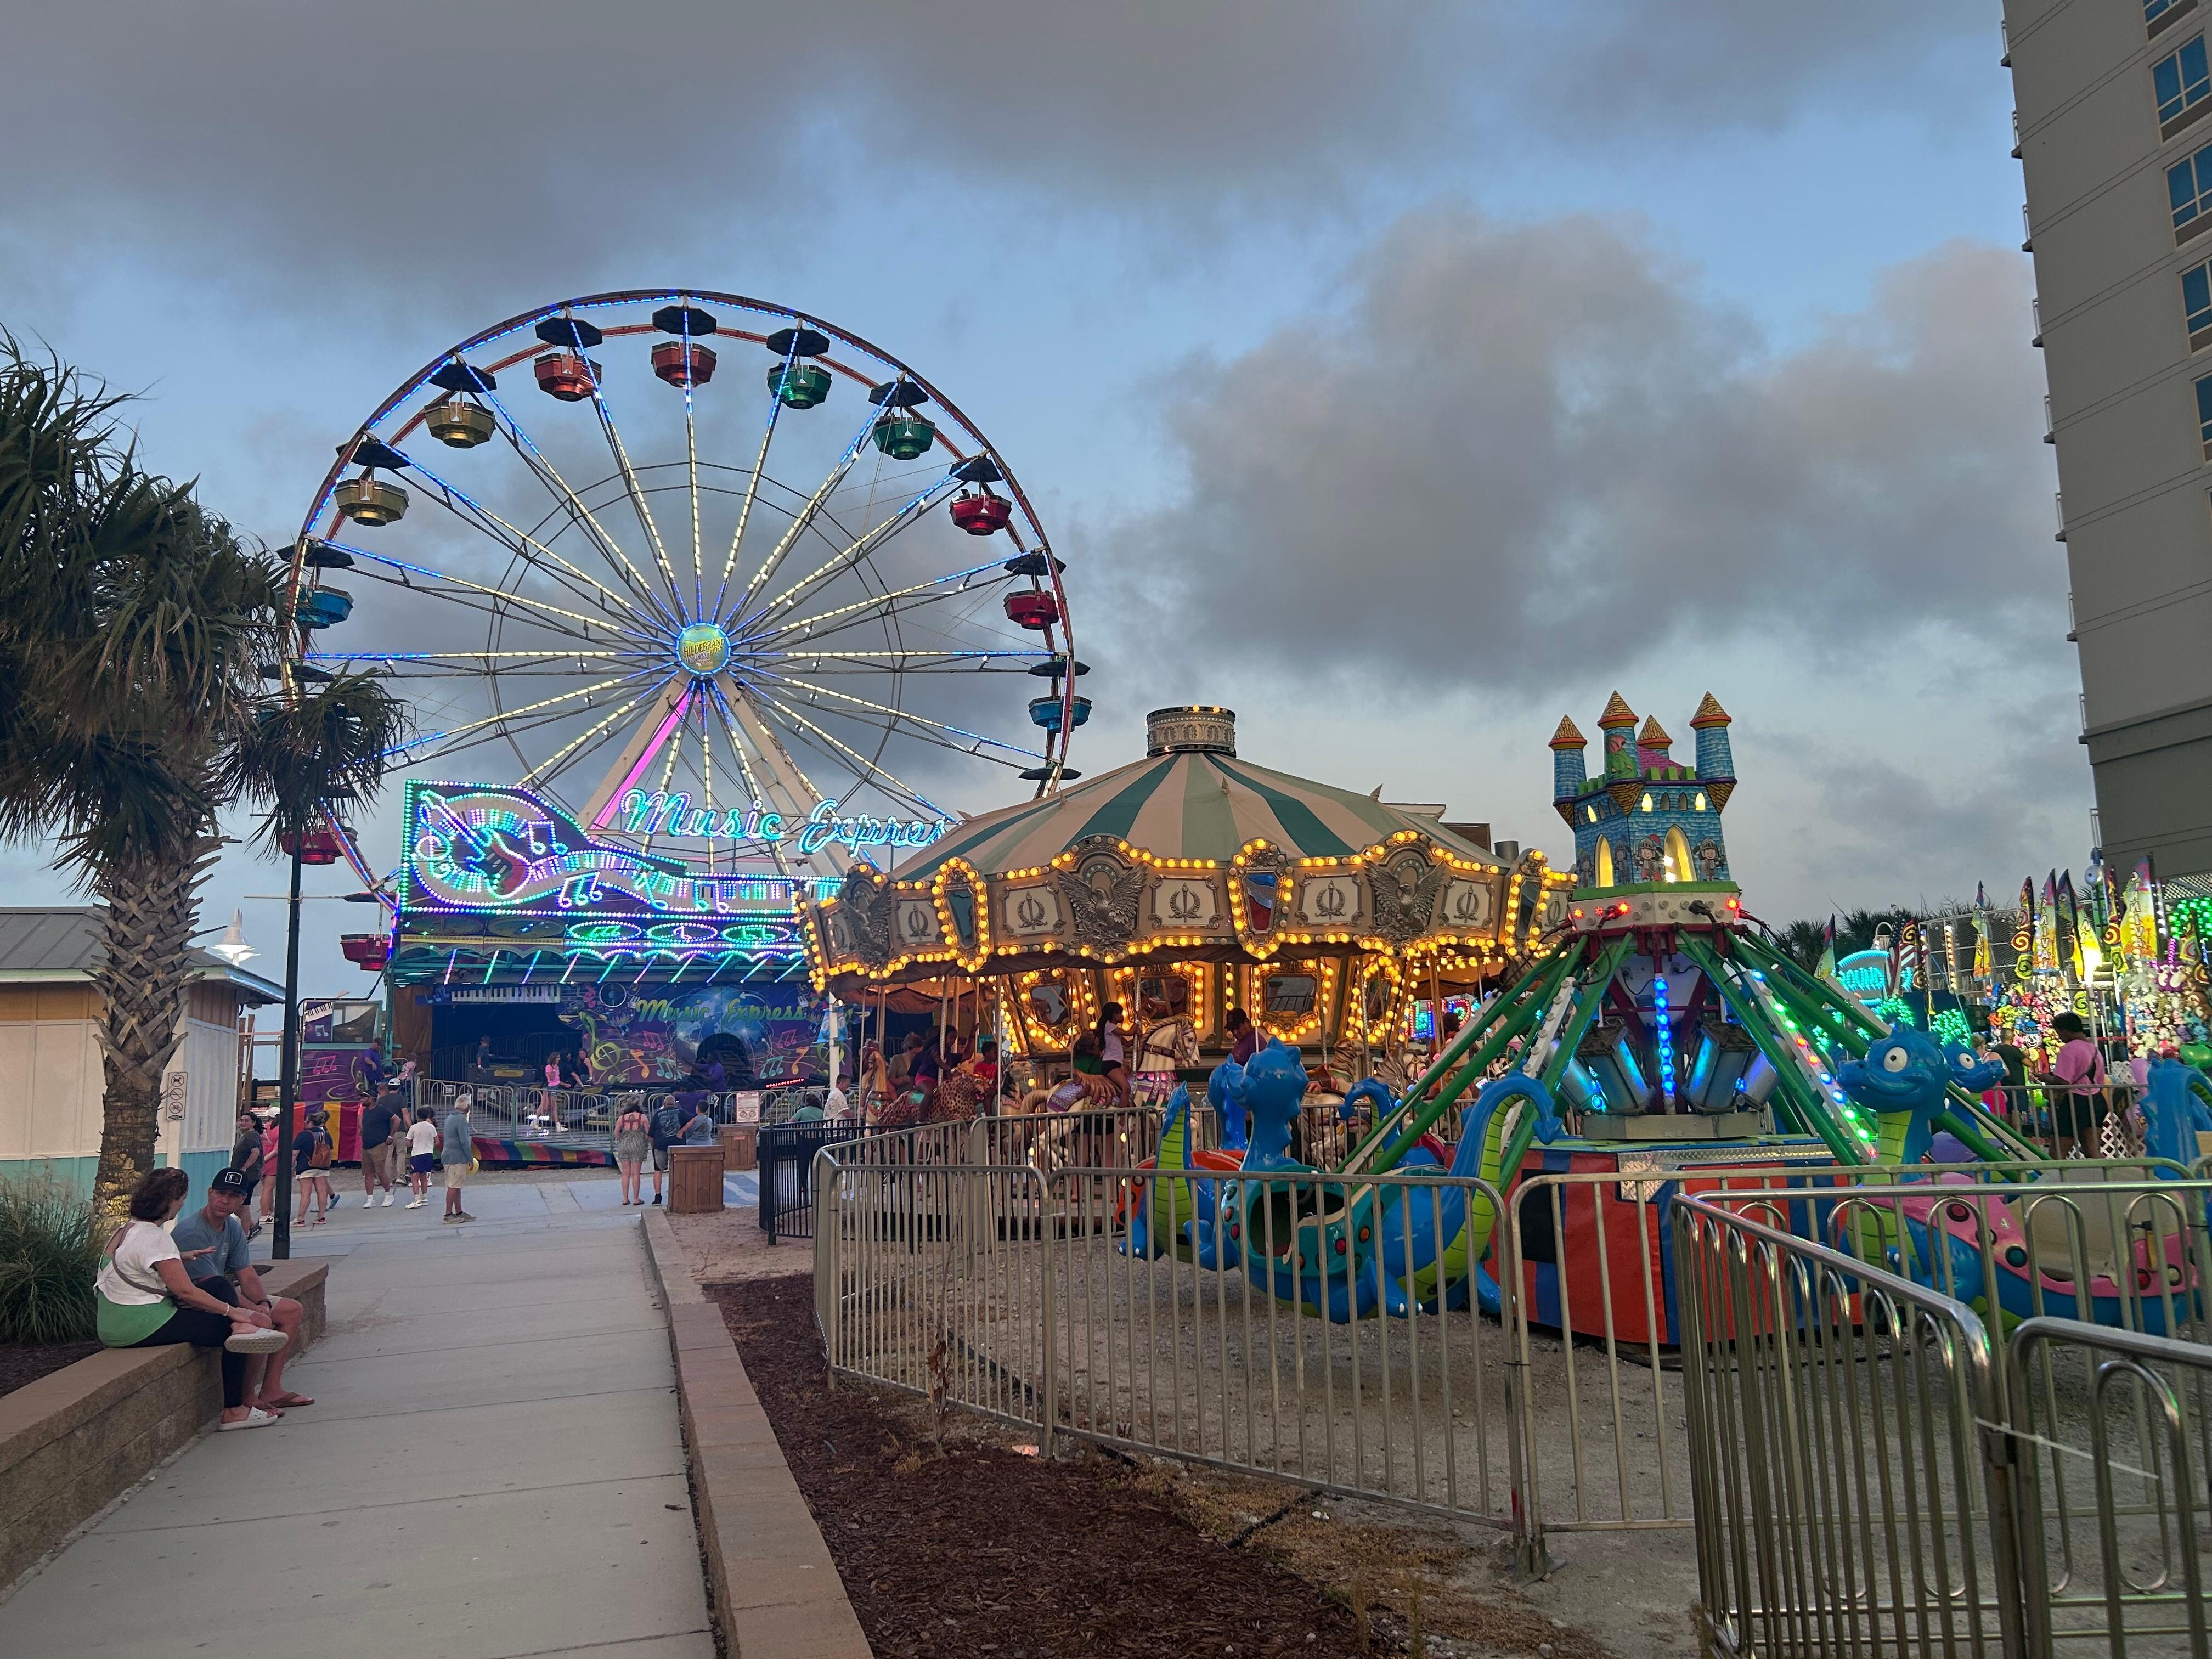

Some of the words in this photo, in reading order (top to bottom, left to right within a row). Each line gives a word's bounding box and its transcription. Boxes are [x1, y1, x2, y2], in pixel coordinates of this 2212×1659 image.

[684, 639, 724, 657] HILDEBRAND
[620, 788, 785, 841] Music
[797, 798, 947, 859] Expres
[635, 998, 710, 1022] Music
[723, 997, 807, 1028] Express
[2001, 1217, 2009, 1229] 4
